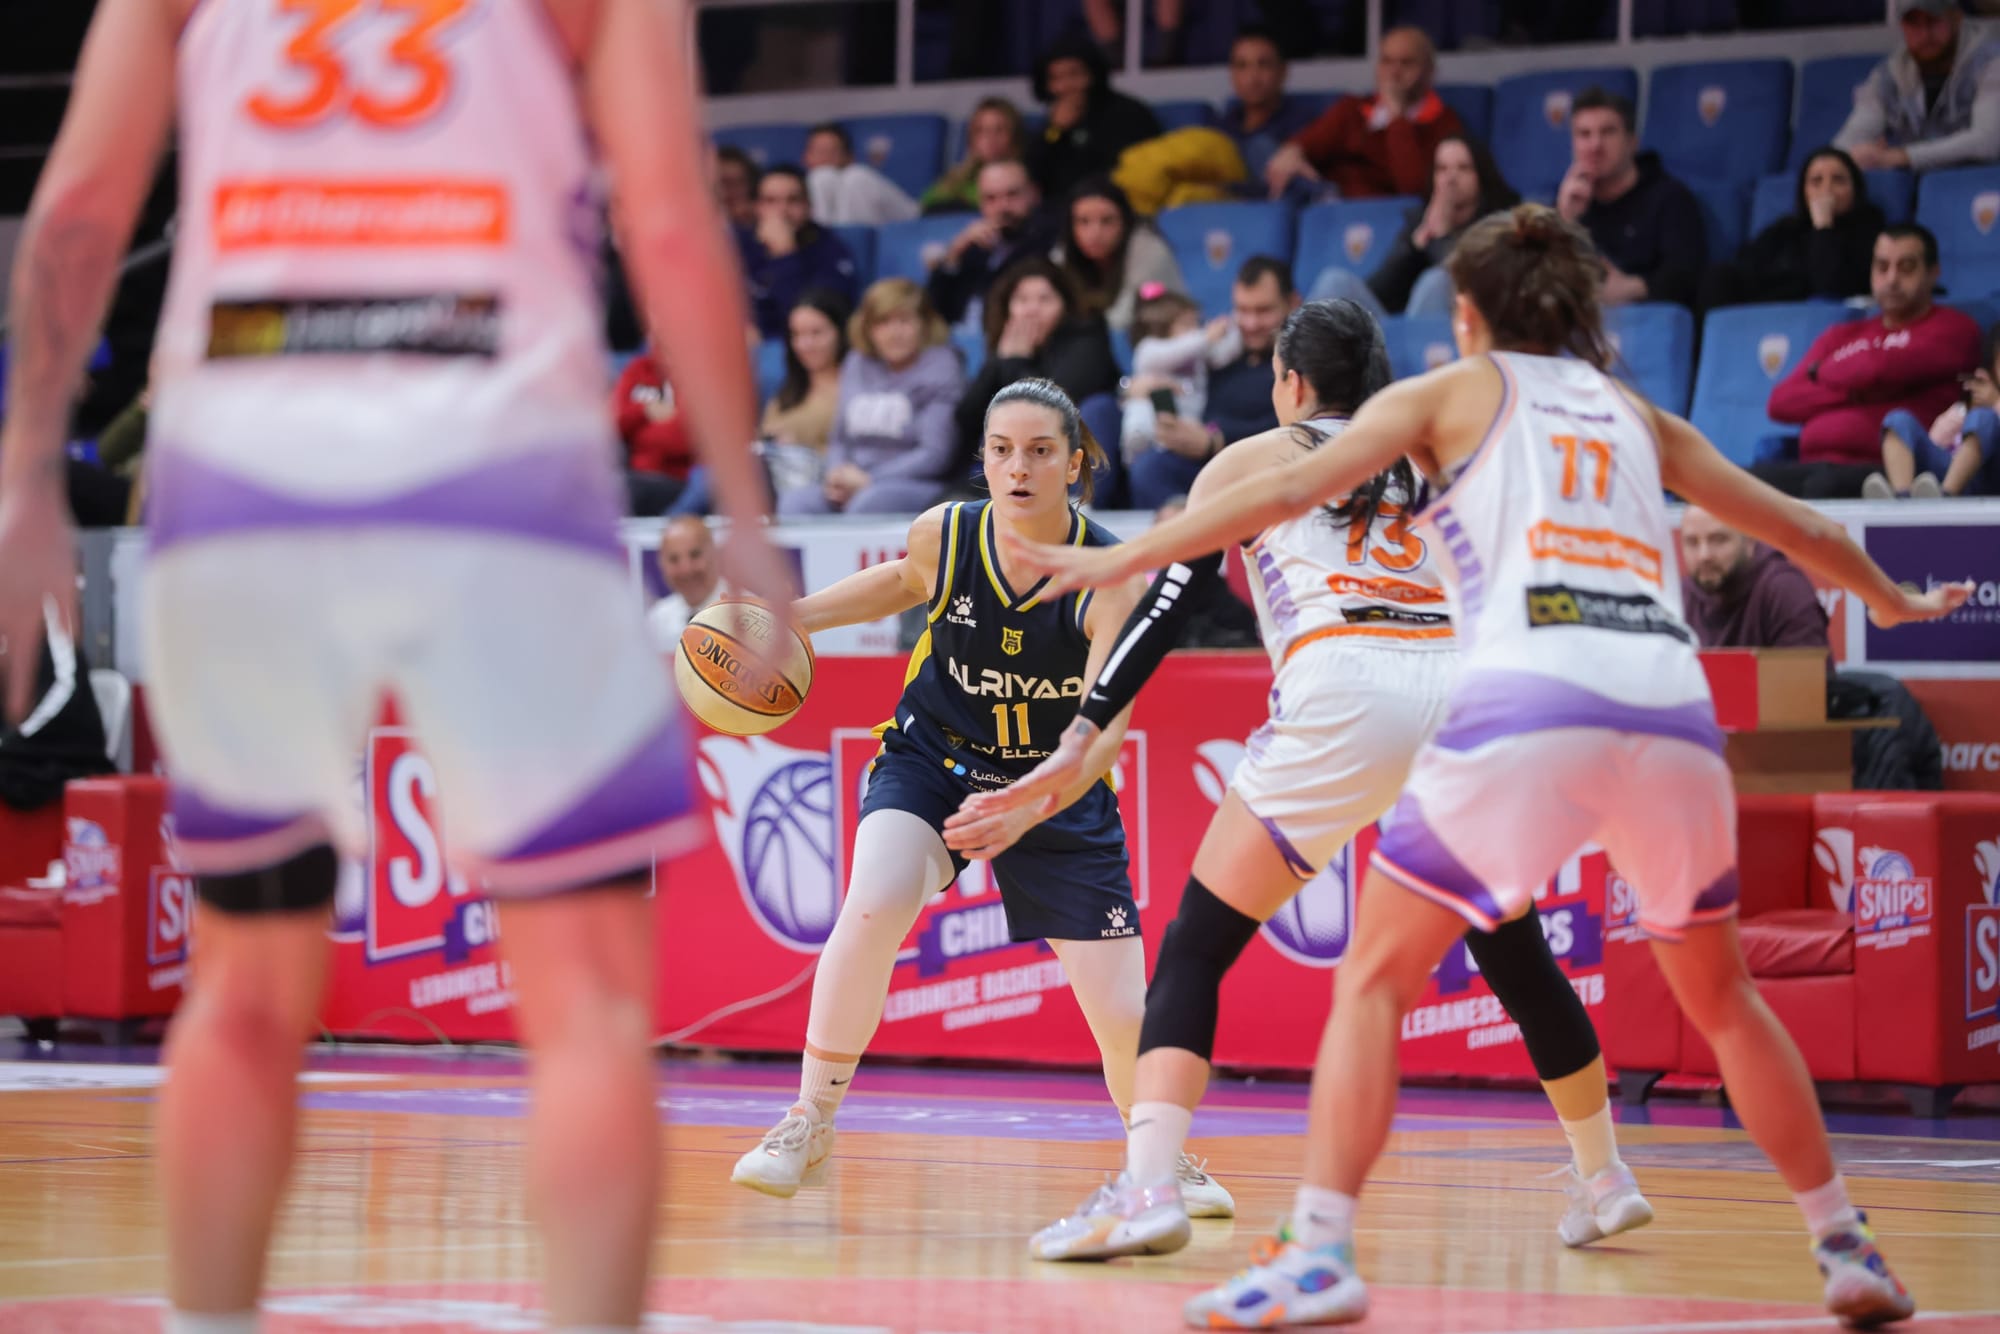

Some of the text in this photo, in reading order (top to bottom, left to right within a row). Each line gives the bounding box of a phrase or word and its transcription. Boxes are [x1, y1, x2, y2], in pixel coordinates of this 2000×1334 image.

[245, 0, 470, 129] 33
[1550, 434, 1614, 504] 11
[946, 613, 977, 628] KELME
[991, 702, 1031, 747] 11
[1101, 926, 1135, 937] KELME
[1401, 994, 1504, 1041] LEBANESE
